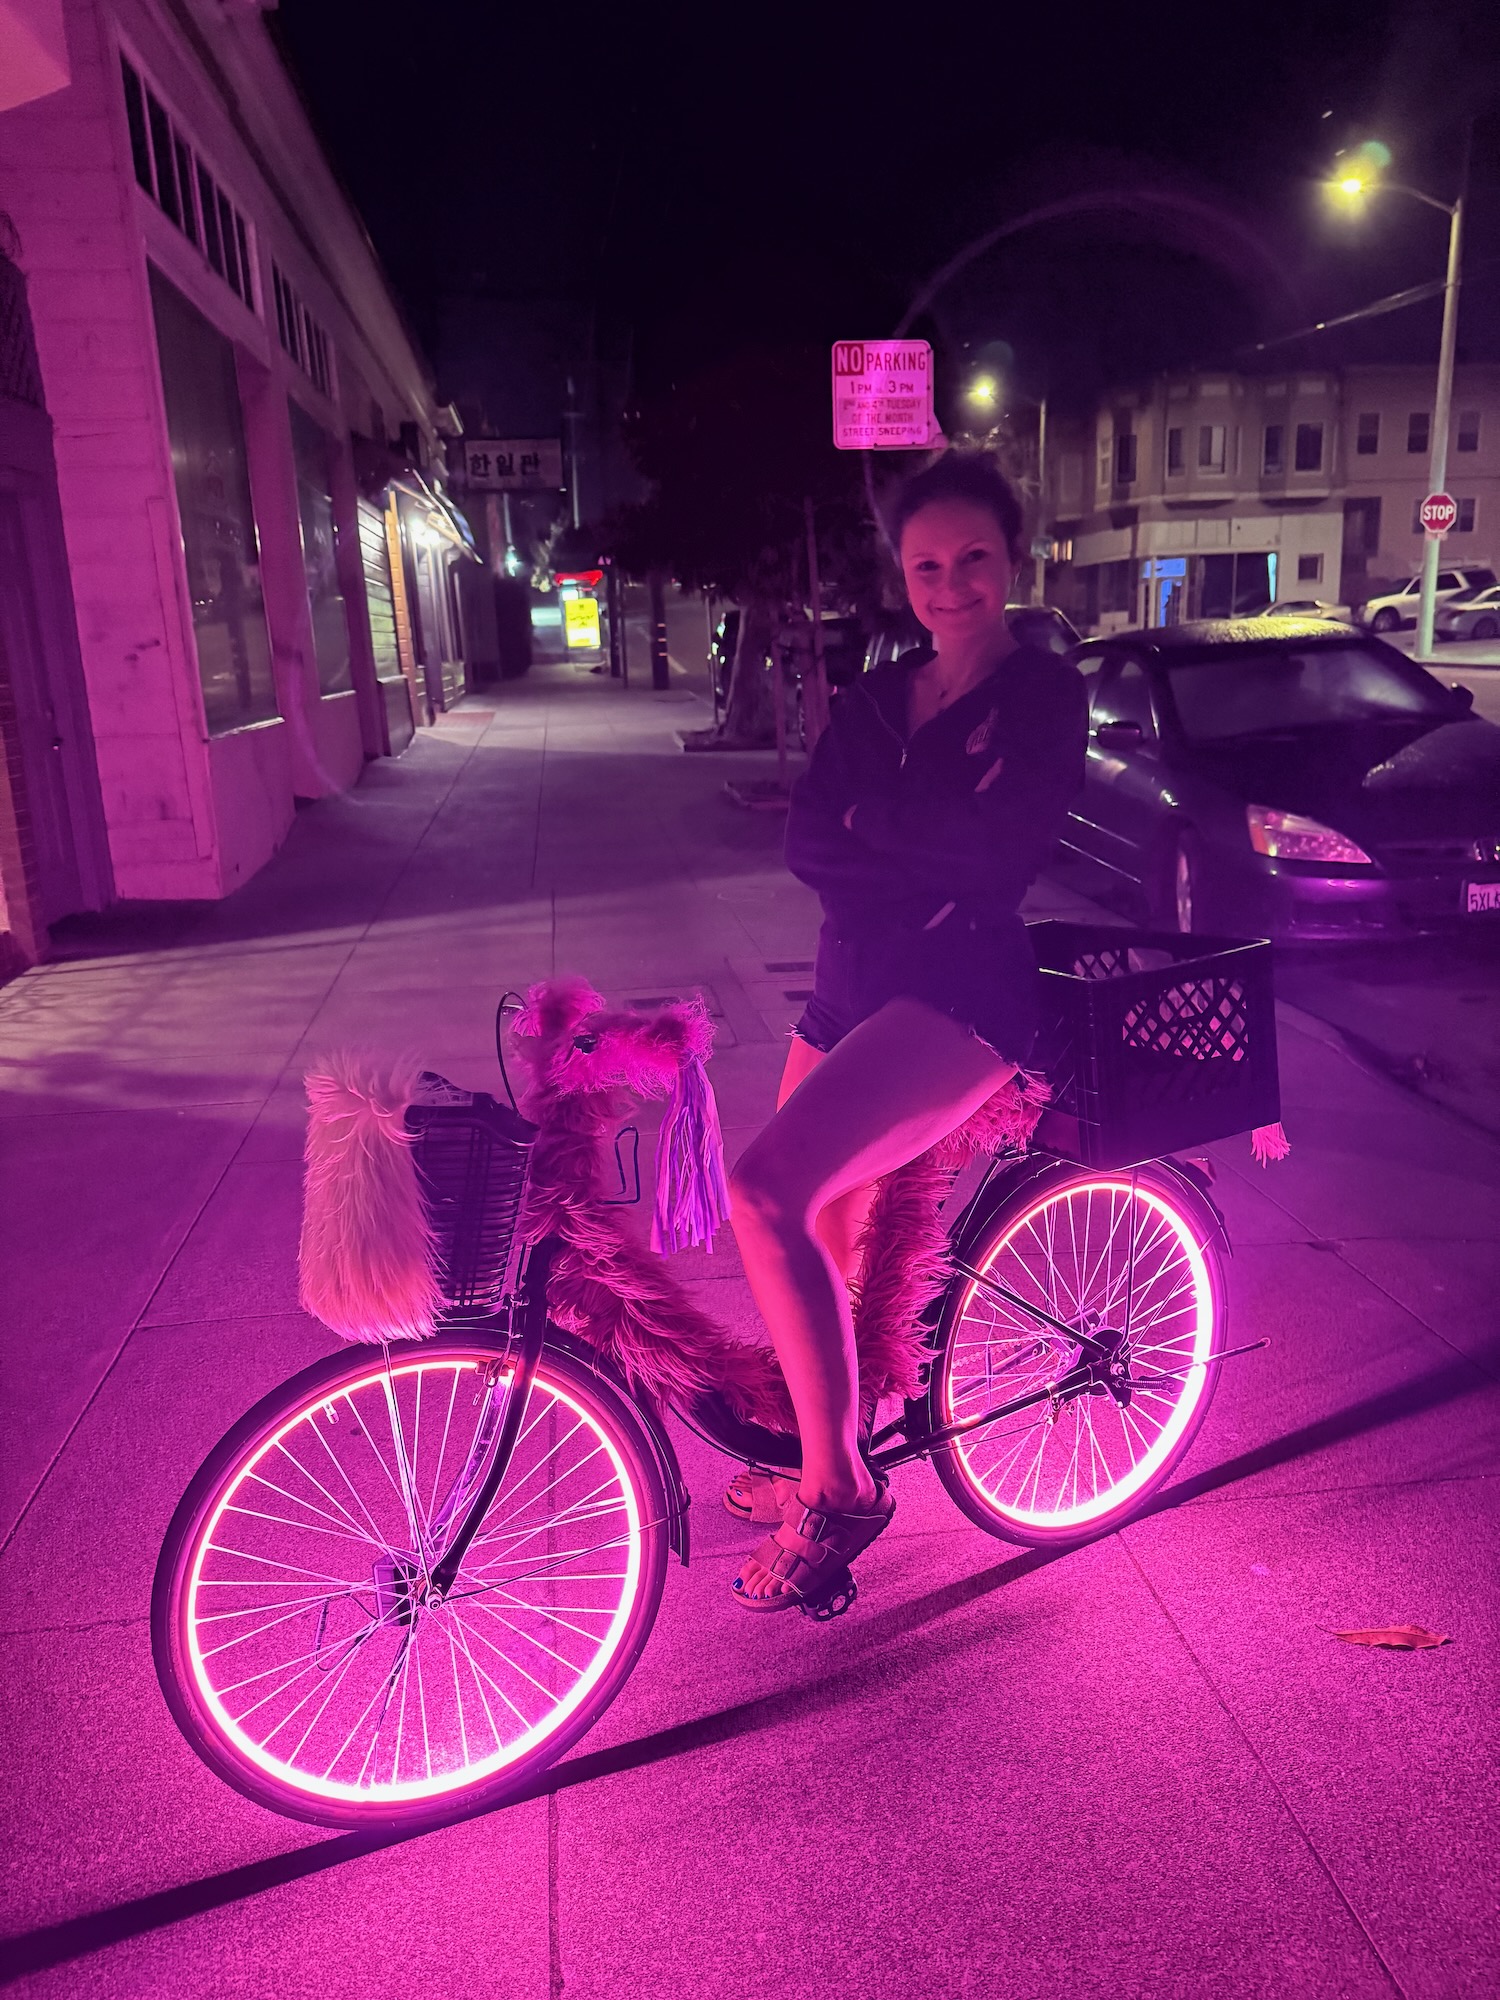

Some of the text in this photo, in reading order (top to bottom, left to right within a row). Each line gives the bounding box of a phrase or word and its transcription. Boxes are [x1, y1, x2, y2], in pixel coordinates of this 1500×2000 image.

[836, 346, 926, 373] NO PARKING
[885, 412, 914, 424] MONTH
[843, 426, 923, 437] STREET SWEEPING
[1423, 505, 1454, 520] STOP
